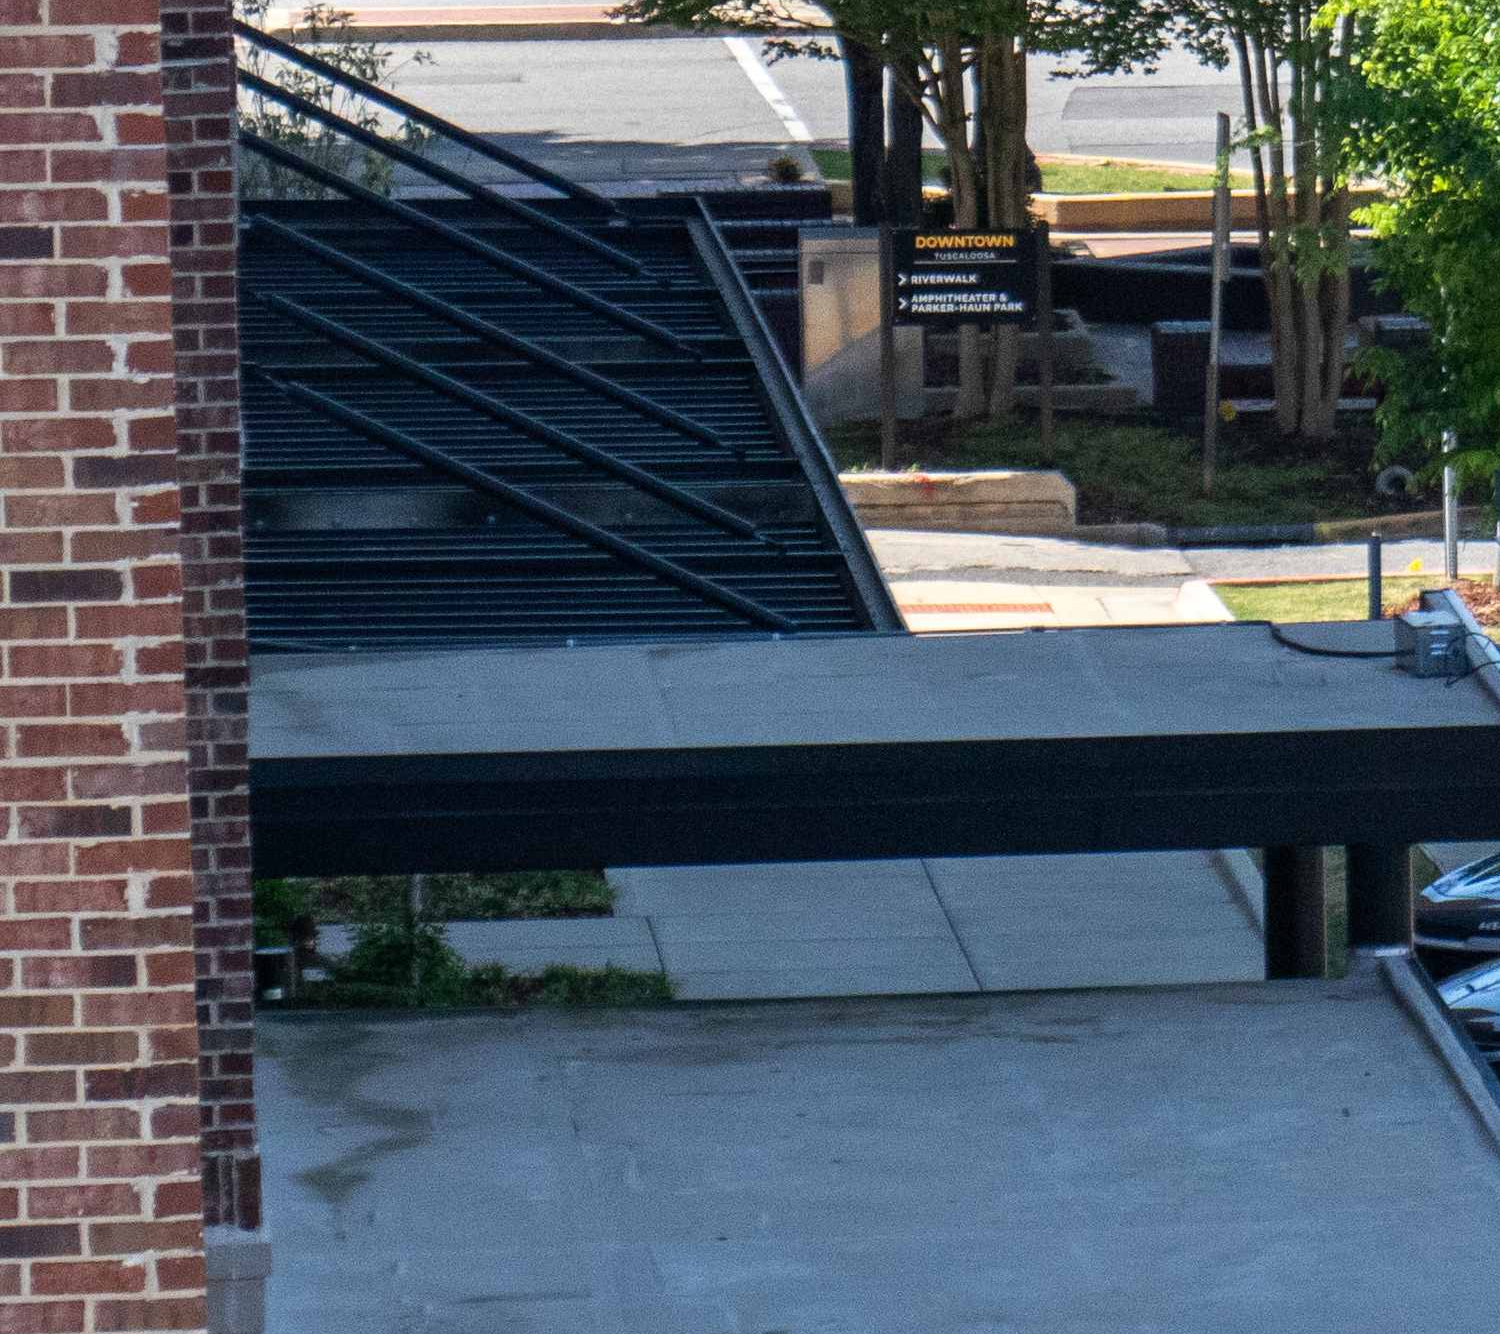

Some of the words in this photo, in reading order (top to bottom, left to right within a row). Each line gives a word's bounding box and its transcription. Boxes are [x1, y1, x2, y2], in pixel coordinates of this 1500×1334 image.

[915, 235, 1016, 249] DOWNTOWN
[933, 251, 997, 261] TUSCALOOSA
[911, 274, 977, 285] RIVERWALK
[911, 293, 996, 304] AMPHITHEATER
[998, 292, 1008, 303] &
[911, 303, 992, 314] PARKER-HAUN
[993, 302, 1024, 312] PARK
